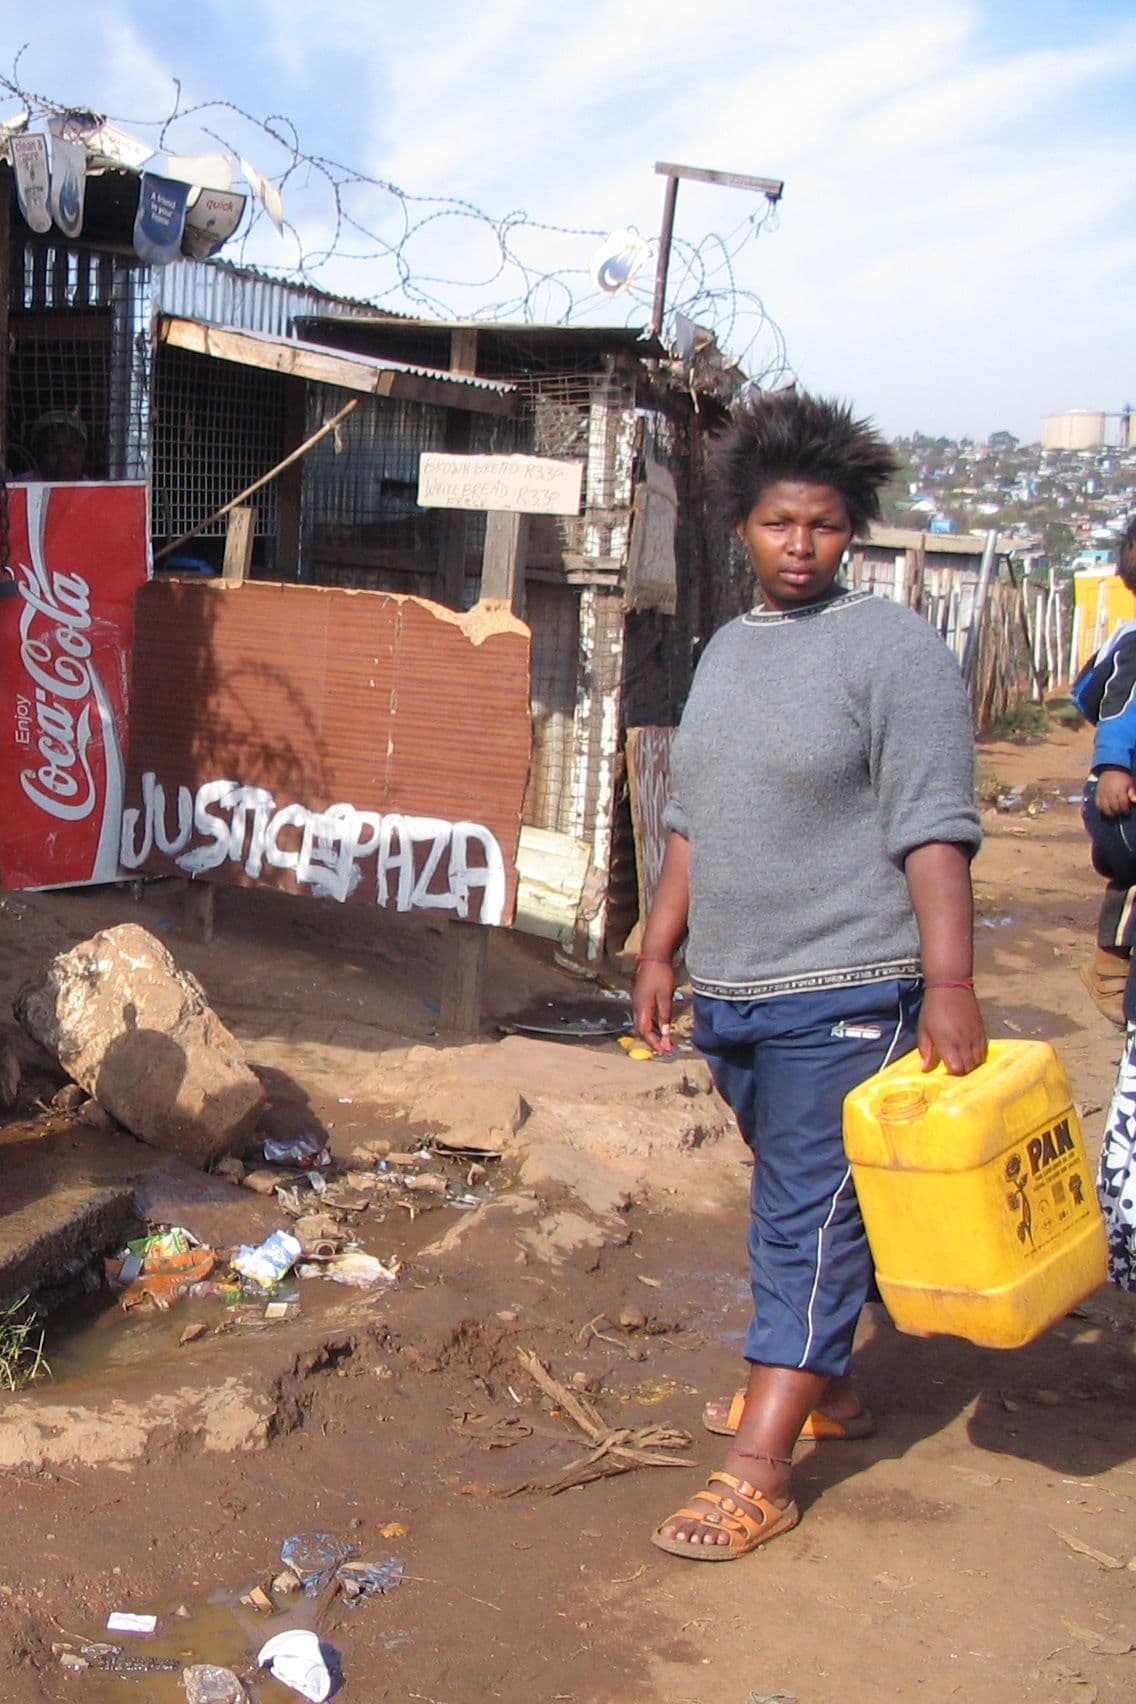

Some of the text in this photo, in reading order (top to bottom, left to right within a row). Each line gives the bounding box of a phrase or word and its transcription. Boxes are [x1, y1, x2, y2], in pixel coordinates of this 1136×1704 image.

[206, 200, 234, 213] quick
[18, 563, 96, 821] Coca-Cola
[15, 696, 31, 745] Enjoy
